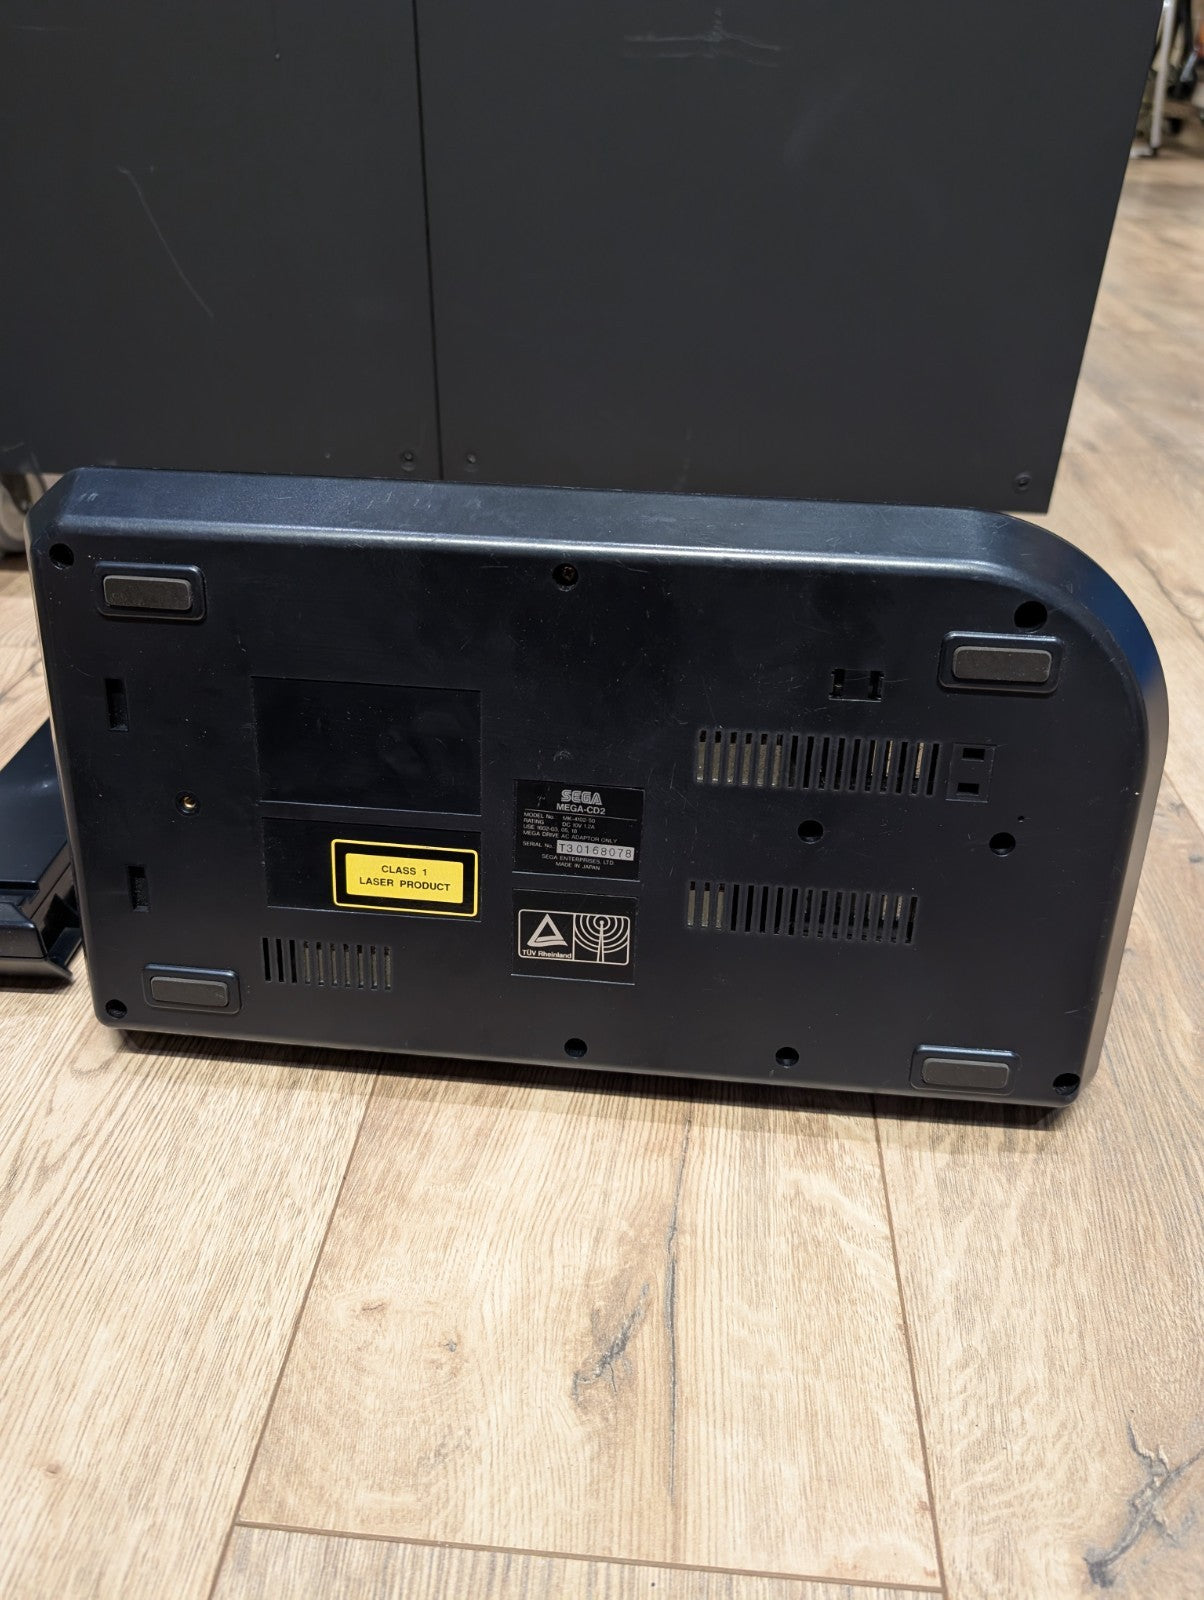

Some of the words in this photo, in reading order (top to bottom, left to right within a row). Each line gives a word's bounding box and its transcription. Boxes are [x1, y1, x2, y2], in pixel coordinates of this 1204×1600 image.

[561, 789, 603, 806] SEGA
[556, 802, 606, 815] MEGA-CD2
[571, 834, 600, 842] ADAPTOR
[522, 840, 543, 848] SERIAL
[559, 843, 632, 859] T30168078
[381, 864, 417, 876] CLASS
[422, 868, 428, 877] 1
[582, 863, 601, 871] JAPAN
[359, 876, 394, 887] LASER
[399, 880, 451, 891] PRODUCT
[537, 950, 572, 959] Rheinland
